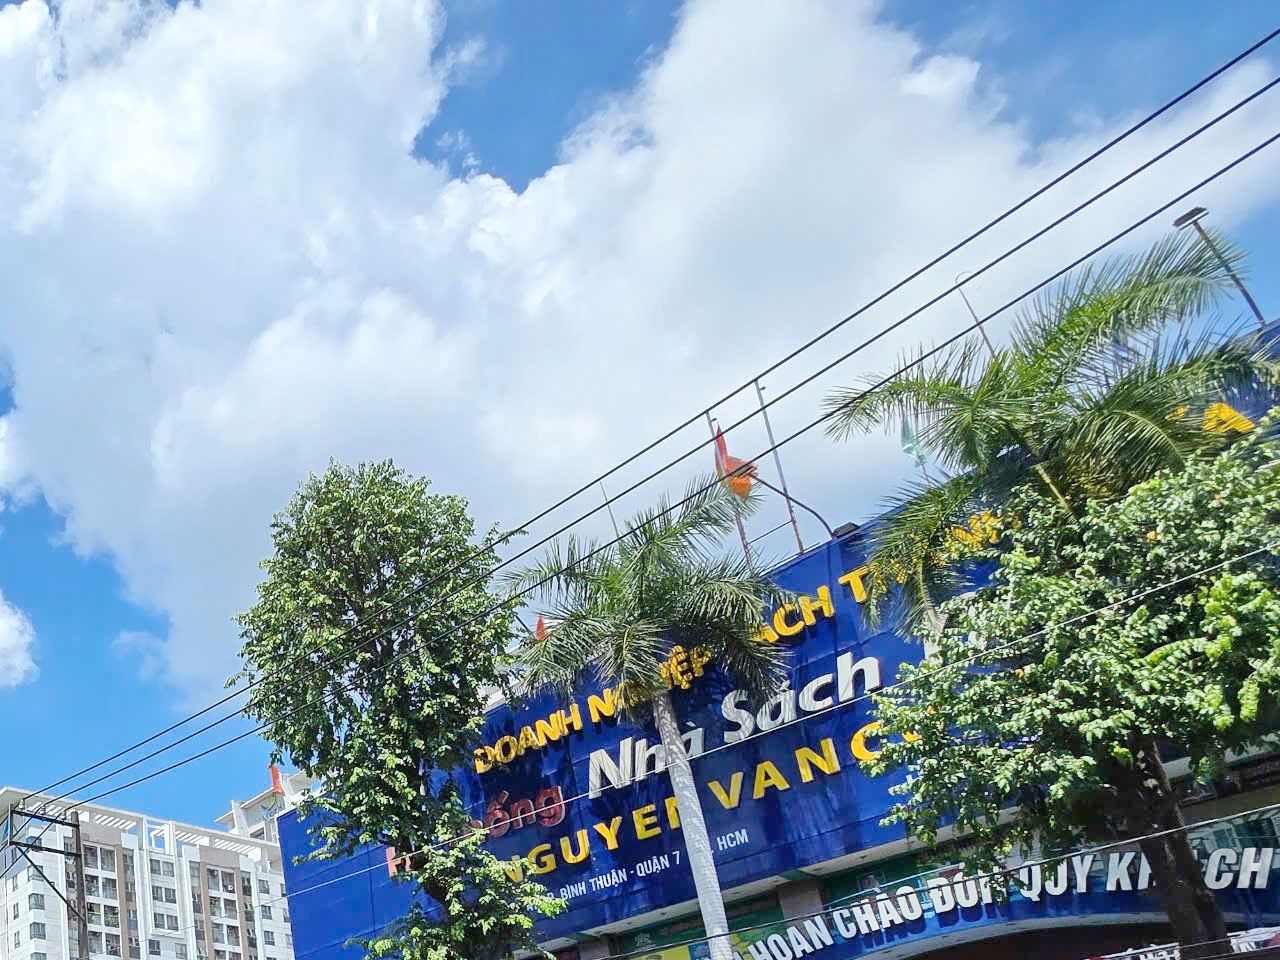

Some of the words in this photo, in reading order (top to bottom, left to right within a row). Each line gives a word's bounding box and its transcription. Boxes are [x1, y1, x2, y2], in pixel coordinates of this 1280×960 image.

[473, 702, 583, 774] DOANH
[587, 645, 712, 723] NỆP
[721, 651, 882, 744] Sách
[559, 882, 587, 902] BÌNH
[589, 868, 628, 893] THUẬN
[636, 856, 670, 879] QUẬN
[672, 850, 682, 866] 7
[716, 828, 749, 851] HCM
[832, 886, 923, 939] CHÀO
